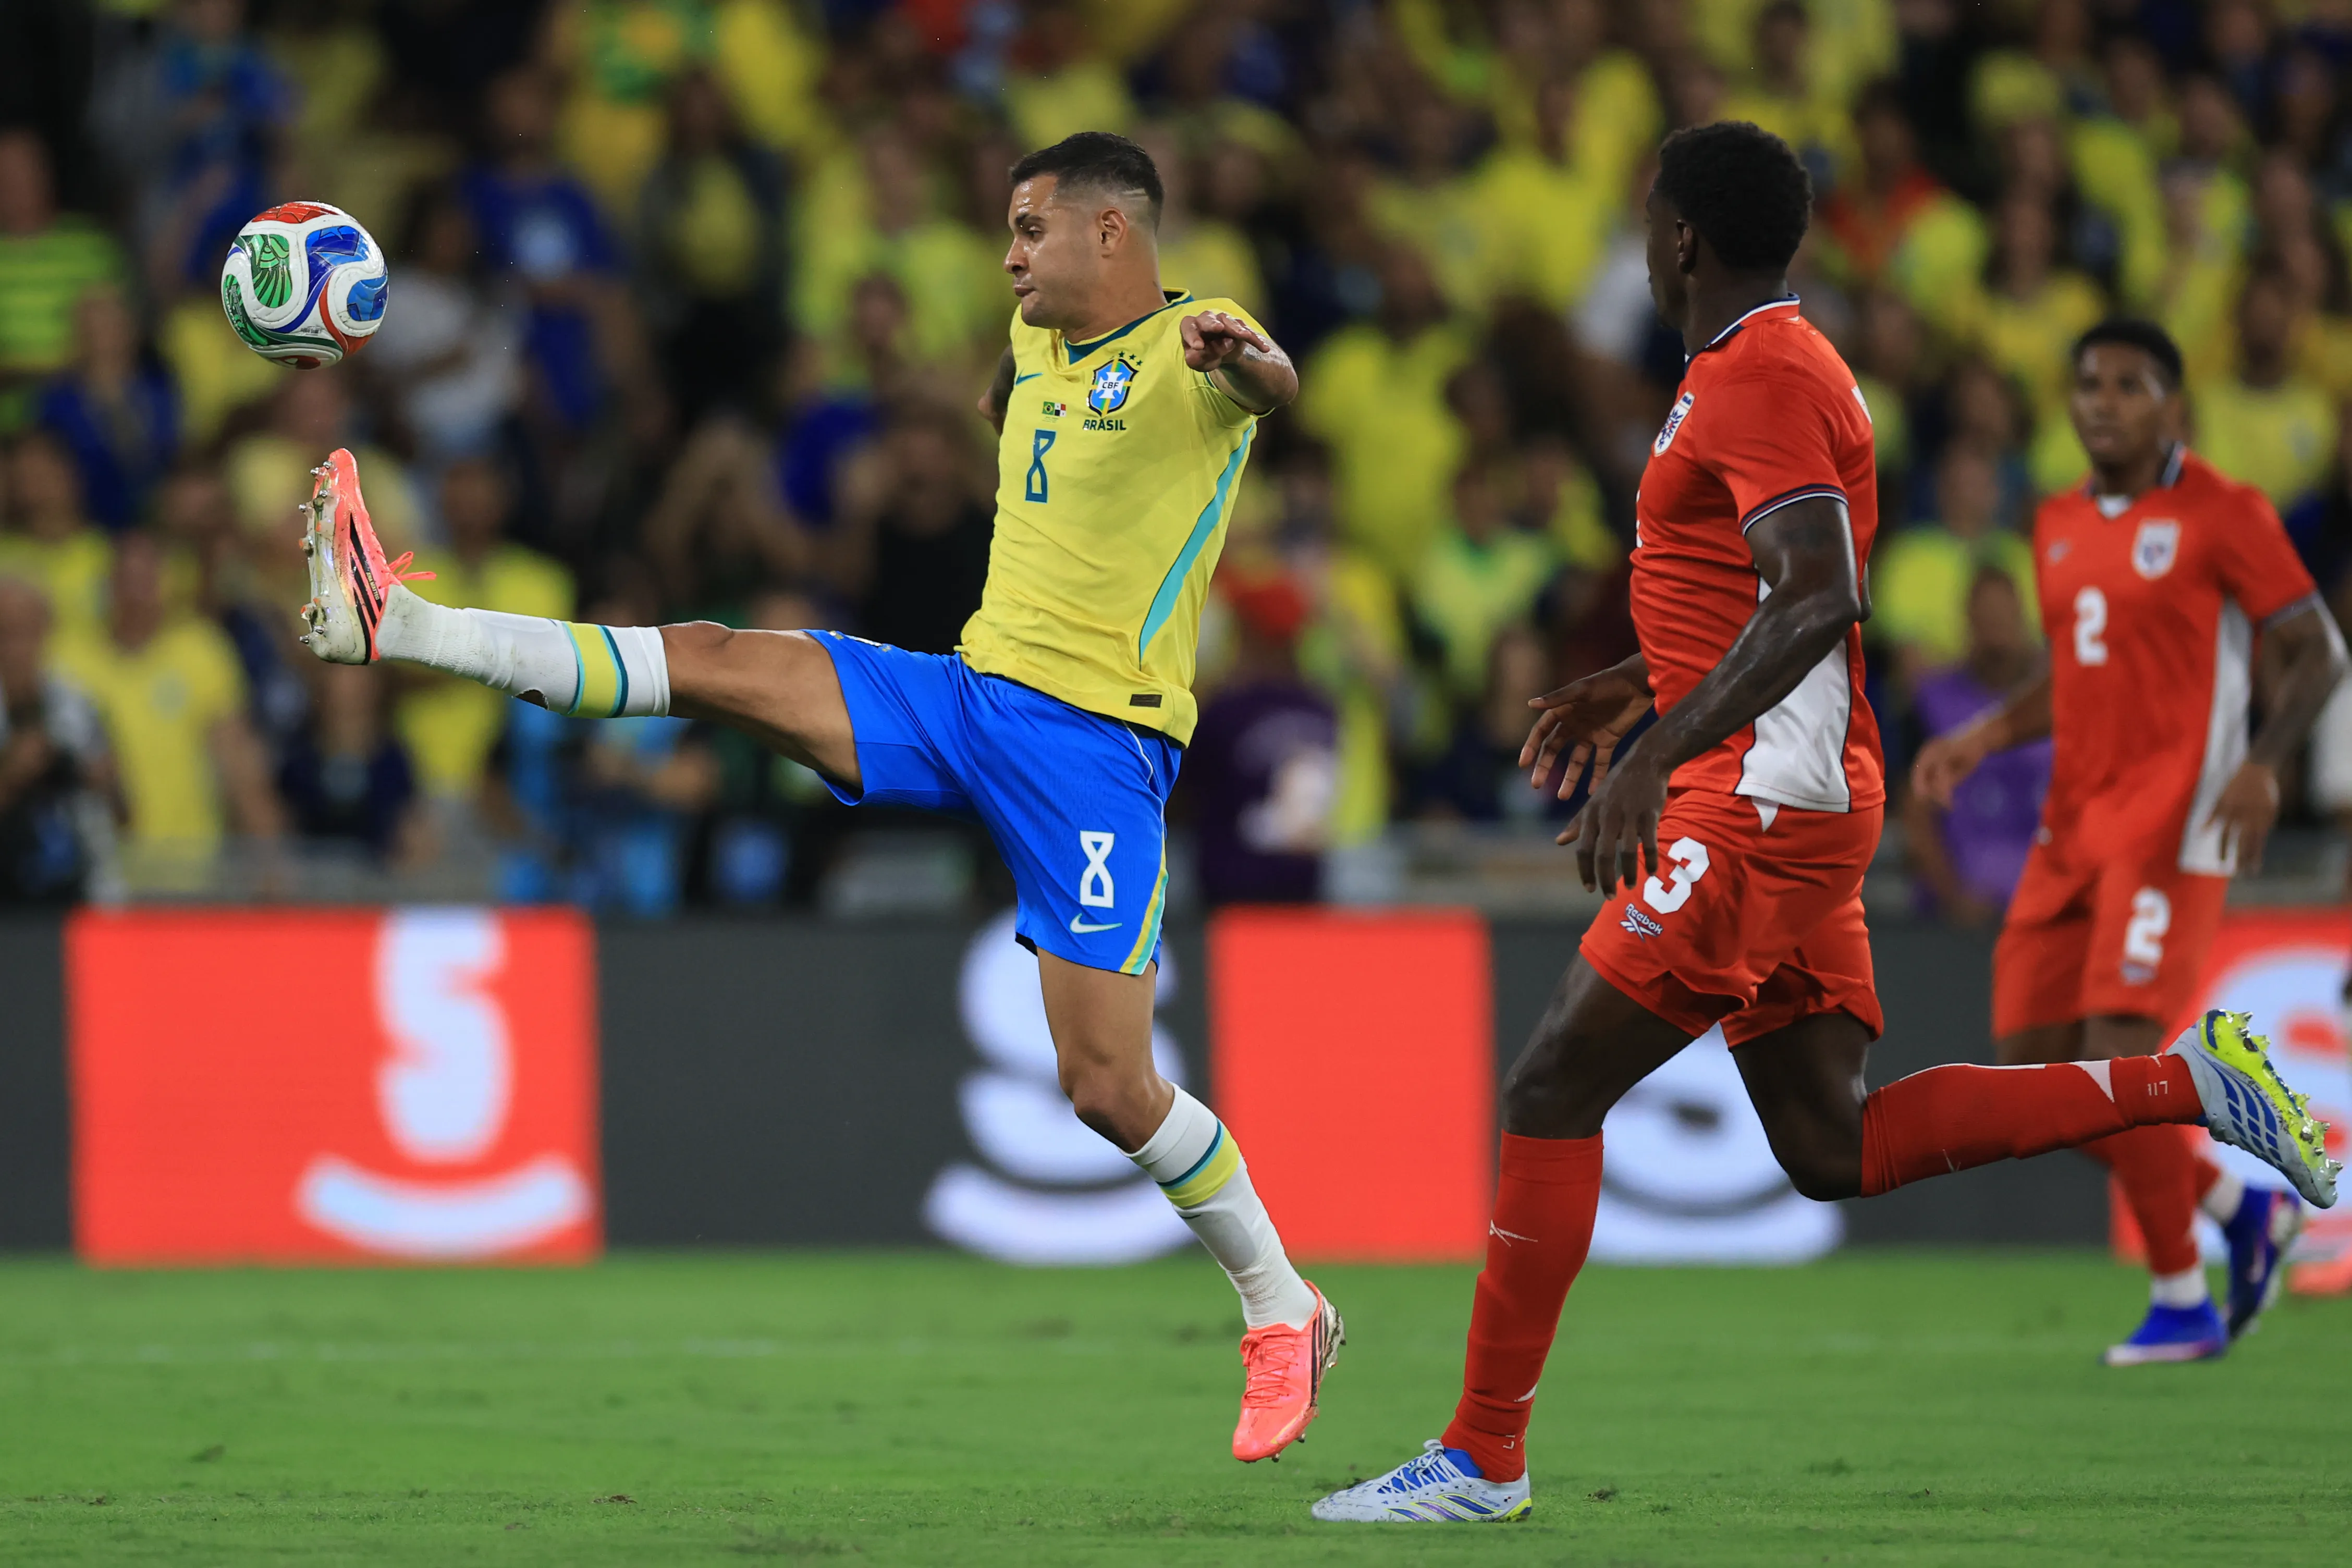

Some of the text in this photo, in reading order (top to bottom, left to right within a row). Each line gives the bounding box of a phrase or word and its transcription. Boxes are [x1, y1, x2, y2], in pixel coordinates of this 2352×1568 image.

[1082, 419, 1127, 431] BRASIL
[1025, 429, 1057, 504] 8
[2074, 585, 2108, 666] 2
[1080, 830, 1115, 909] 8
[1643, 836, 1710, 914] 3
[1626, 902, 1663, 935] Reebok
[2124, 885, 2172, 963] 2
